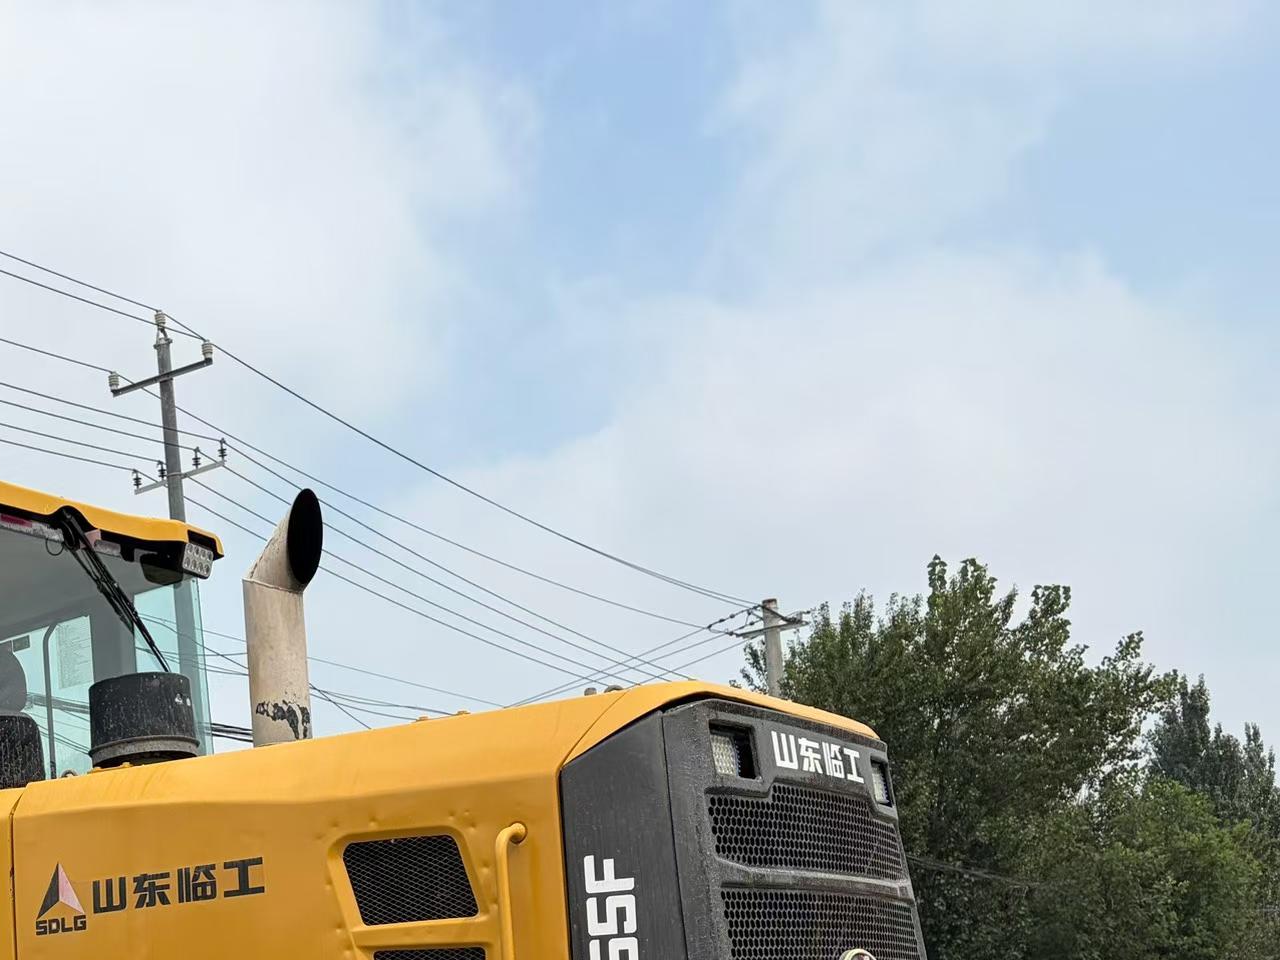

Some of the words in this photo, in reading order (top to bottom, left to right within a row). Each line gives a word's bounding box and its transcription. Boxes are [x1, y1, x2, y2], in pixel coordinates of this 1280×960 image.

[771, 731, 864, 784] 山东临工
[92, 857, 265, 914] 山东临工
[35, 915, 87, 936] SDLG
